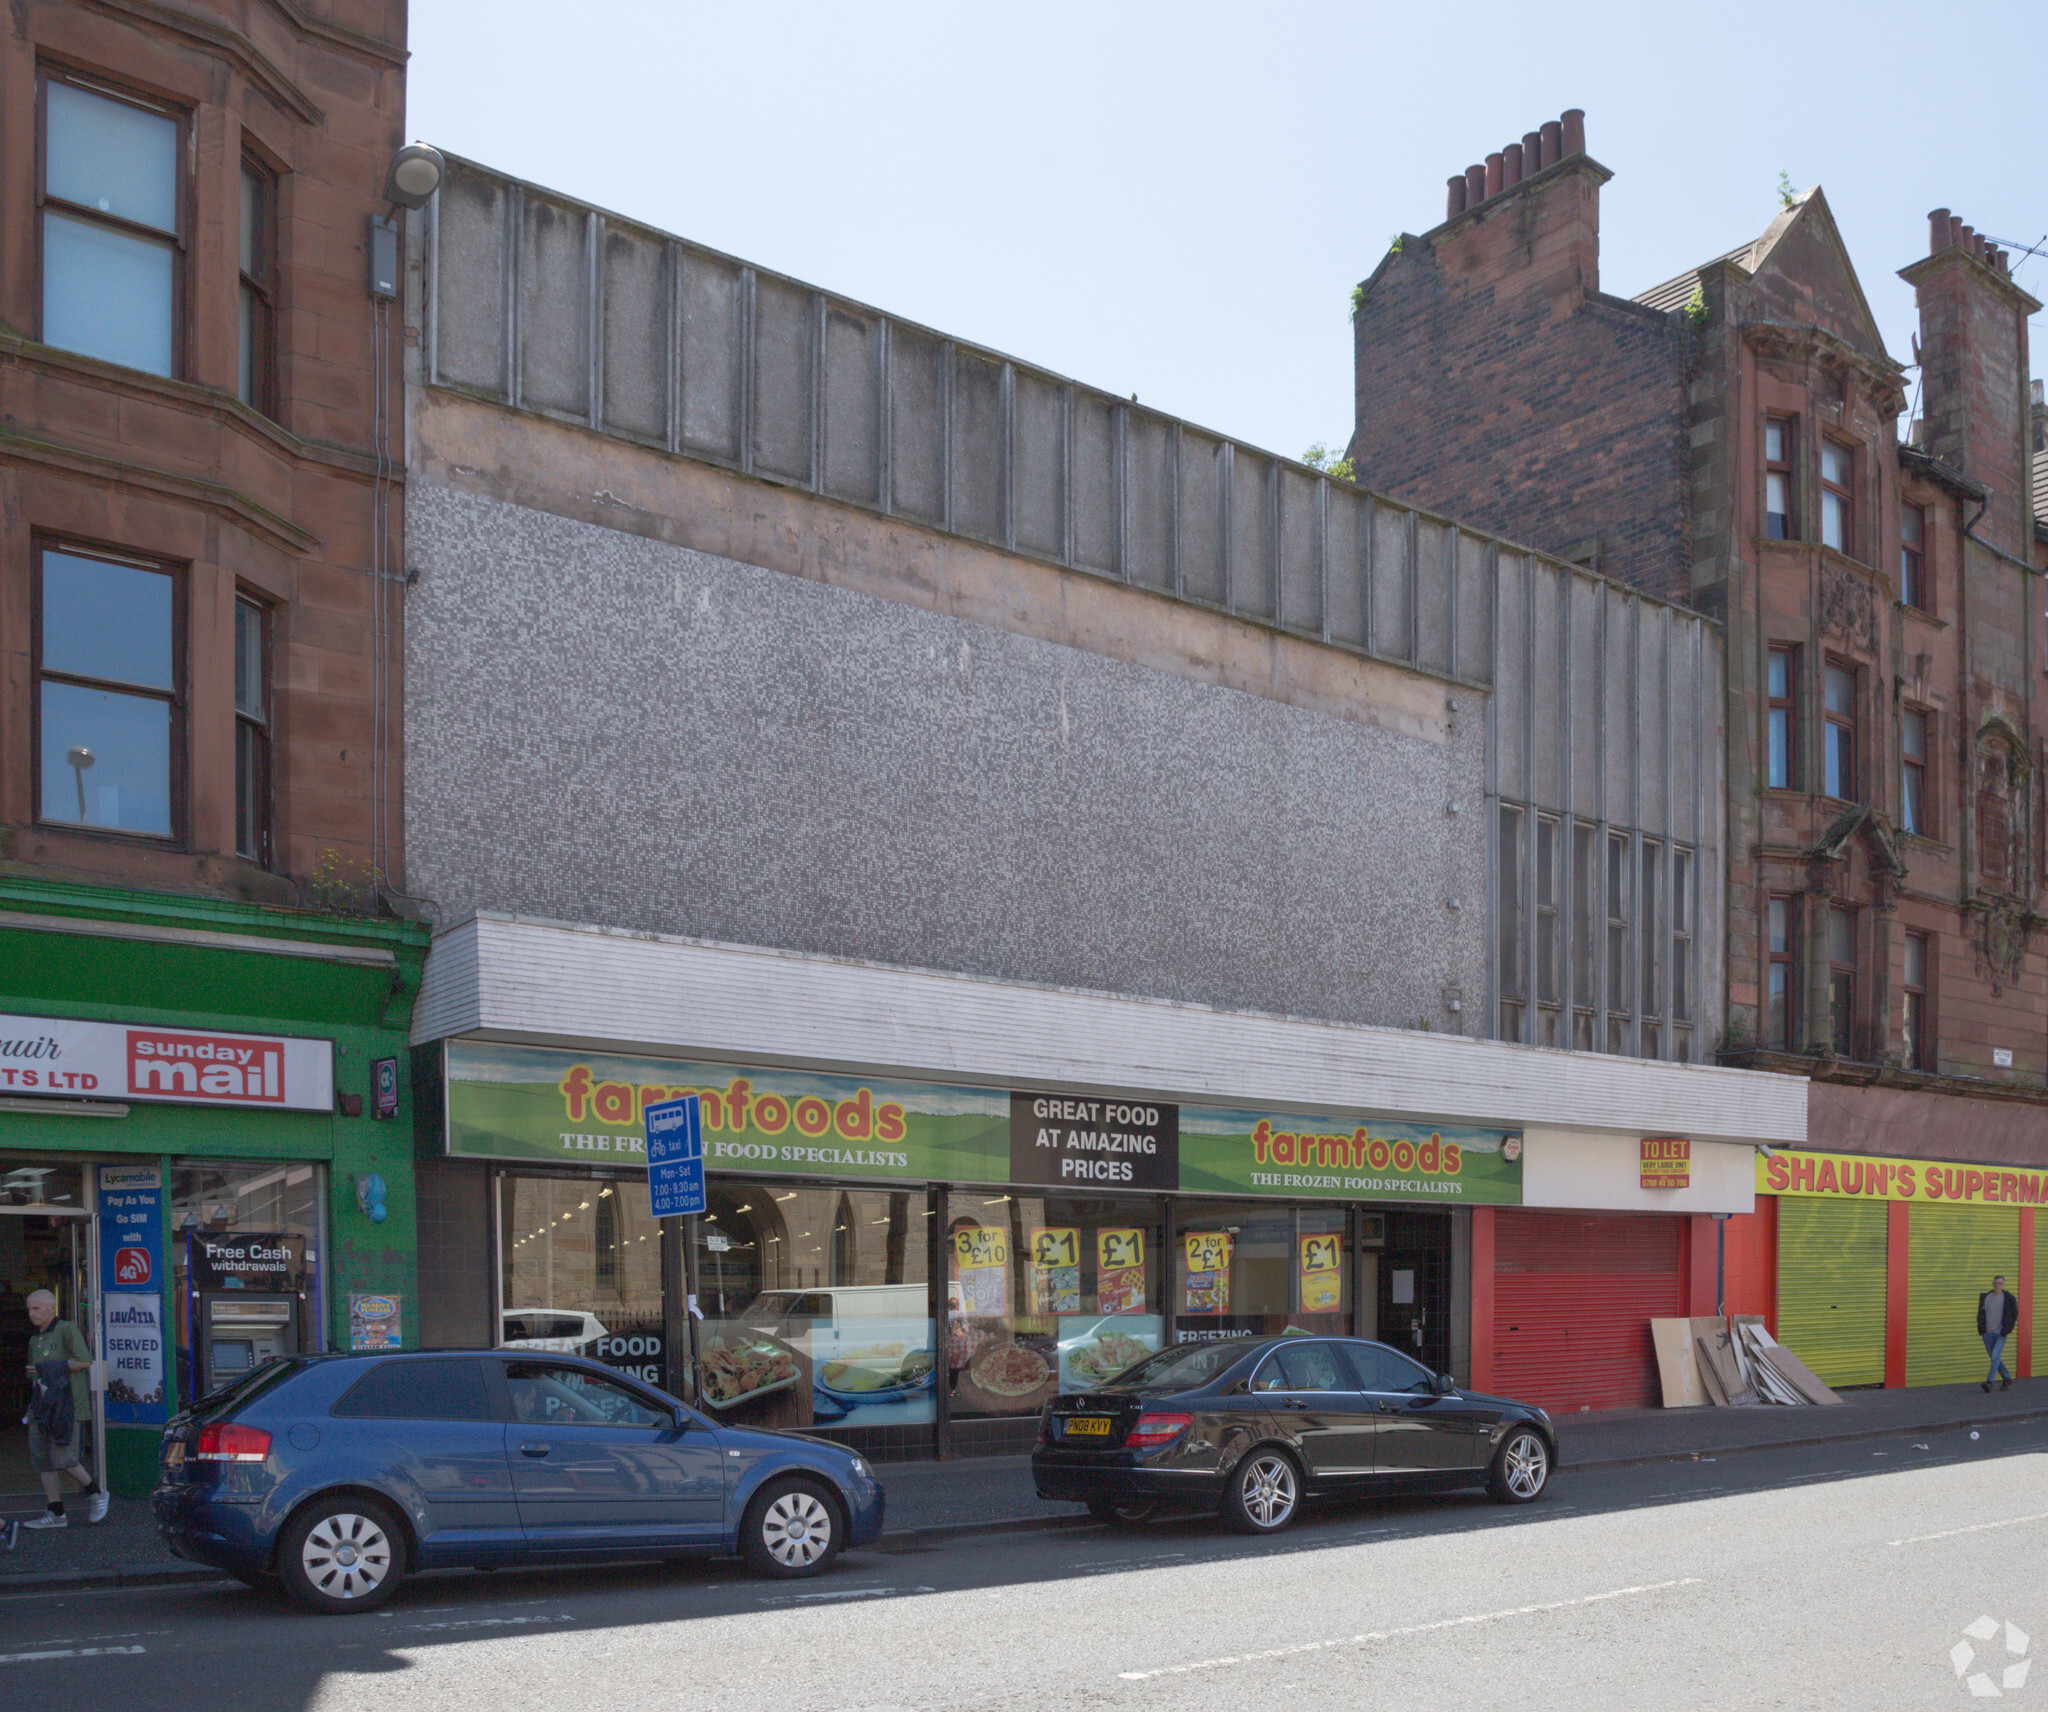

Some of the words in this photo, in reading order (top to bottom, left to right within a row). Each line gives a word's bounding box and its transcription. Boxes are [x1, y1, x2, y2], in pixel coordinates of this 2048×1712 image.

[135, 1041, 254, 1065] sunday
[48, 1071, 98, 1090] LTD
[134, 1051, 279, 1097] mail
[1033, 1098, 1100, 1122] GREAT
[1105, 1104, 1159, 1126] FOOD
[559, 1133, 612, 1153] THE
[714, 1142, 778, 1161] FOOD
[781, 1147, 908, 1168] SPECIALISTS
[668, 1139, 682, 1152] taxi
[1035, 1128, 1061, 1148] AT
[1066, 1130, 1156, 1154] AMAZING
[1251, 1118, 1463, 1175] farmfoods
[1642, 1141, 1660, 1158] TO
[1663, 1141, 1688, 1158] LET
[1061, 1158, 1133, 1181] PRICES
[1642, 1161, 1657, 1169] VERY
[1657, 1161, 1675, 1169] LARGE
[1674, 1161, 1688, 1169] UNIT
[1766, 1154, 1916, 1197] SHAUN'S
[104, 1172, 156, 1185] Lycamobile
[1250, 1172, 1281, 1186] THE
[1283, 1174, 1341, 1189] FROZEN
[1343, 1177, 1383, 1191] FOOD
[1384, 1179, 1463, 1194] SPECIALISTS
[107, 1195, 124, 1207] Pay
[125, 1195, 137, 1206] As
[138, 1194, 156, 1205] You
[116, 1214, 129, 1224] Go
[130, 1213, 148, 1224] SIM
[122, 1232, 142, 1242] with
[958, 1231, 973, 1254] 3
[977, 1230, 998, 1243] for
[1188, 1238, 1202, 1258] 2
[1205, 1236, 1223, 1248] for
[206, 1243, 245, 1259] Free
[249, 1244, 292, 1260] Cash
[971, 1244, 1006, 1265] £10
[1035, 1231, 1076, 1267] £1
[1102, 1231, 1140, 1268] £1
[1201, 1247, 1225, 1270] £1
[1305, 1237, 1337, 1271] £1
[119, 1265, 137, 1280] 4G
[210, 1260, 287, 1272] withdrawals
[109, 1306, 156, 1324] LAVAZZA
[109, 1338, 159, 1352] SERVED
[596, 1336, 662, 1357] FOOD
[116, 1357, 152, 1370] HERE
[1068, 1420, 1090, 1432] PN08
[1090, 1420, 1109, 1433] KVY
